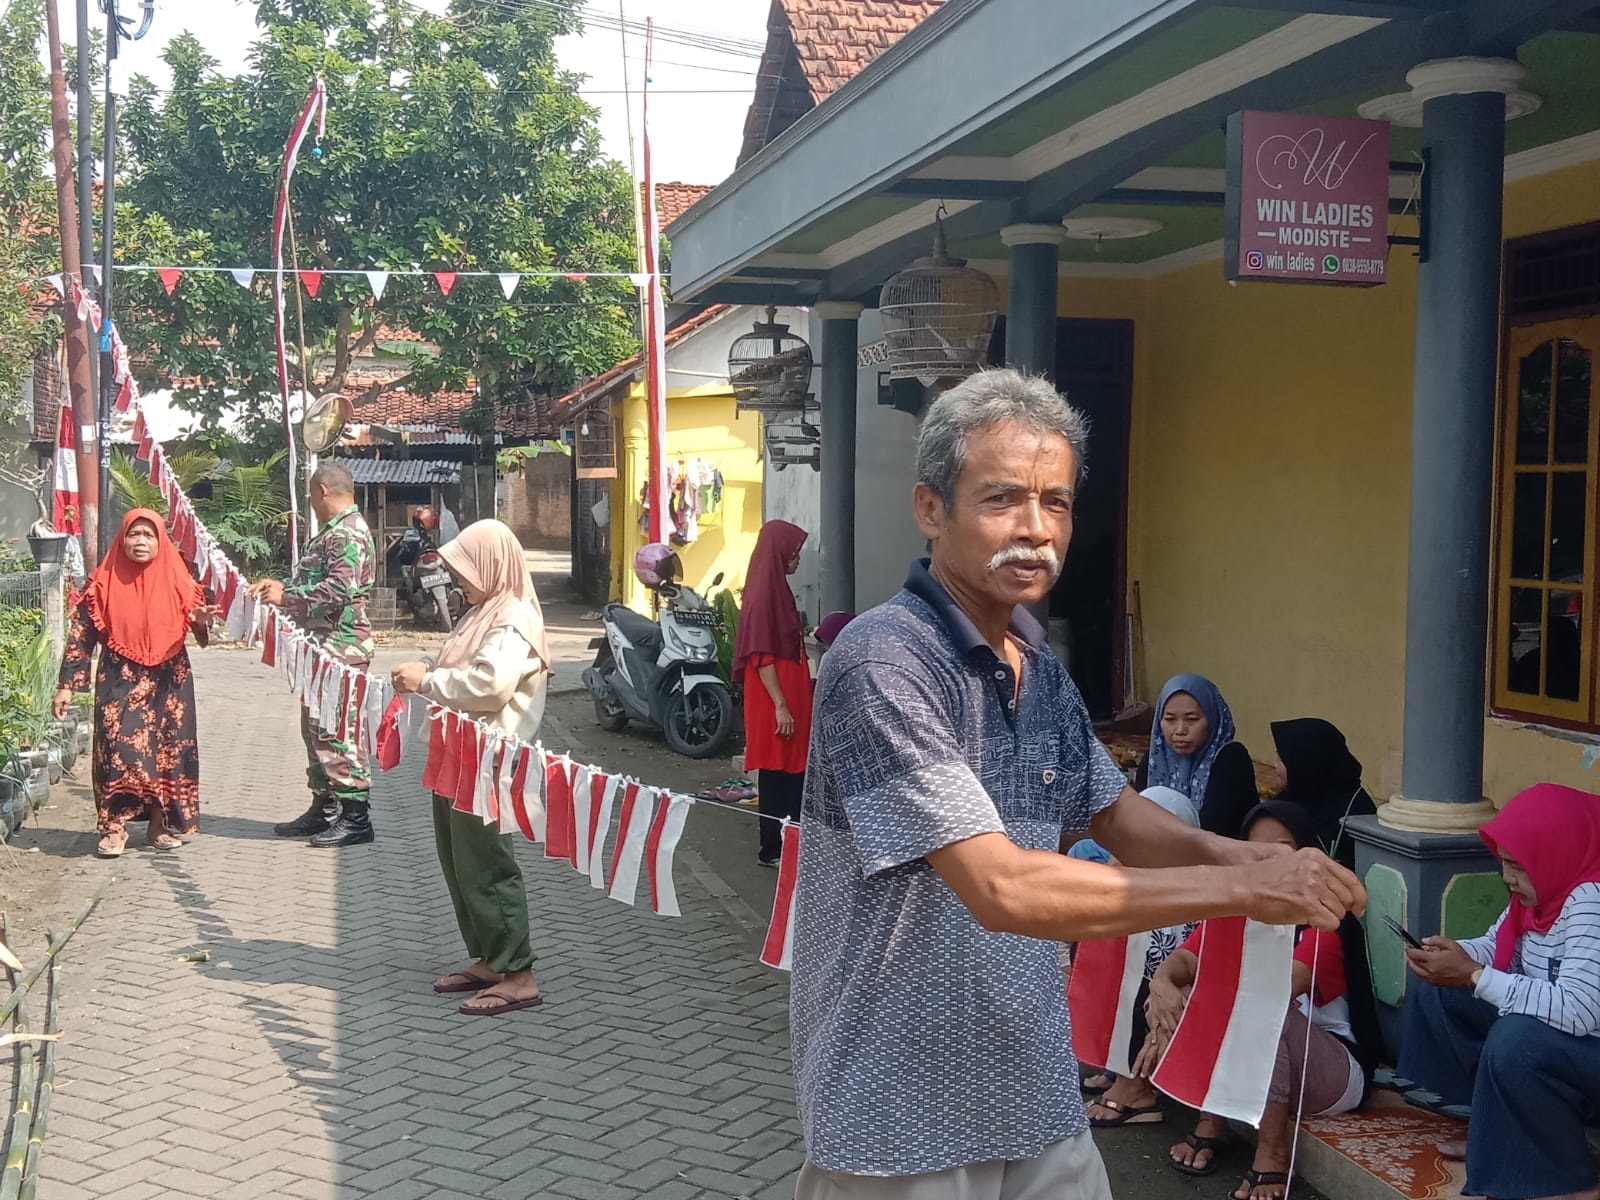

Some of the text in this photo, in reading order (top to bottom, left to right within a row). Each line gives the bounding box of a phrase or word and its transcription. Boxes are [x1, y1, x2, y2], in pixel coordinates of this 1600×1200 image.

[1257, 198, 1374, 228] WIN LADIES
[1279, 226, 1350, 248] MODISTE
